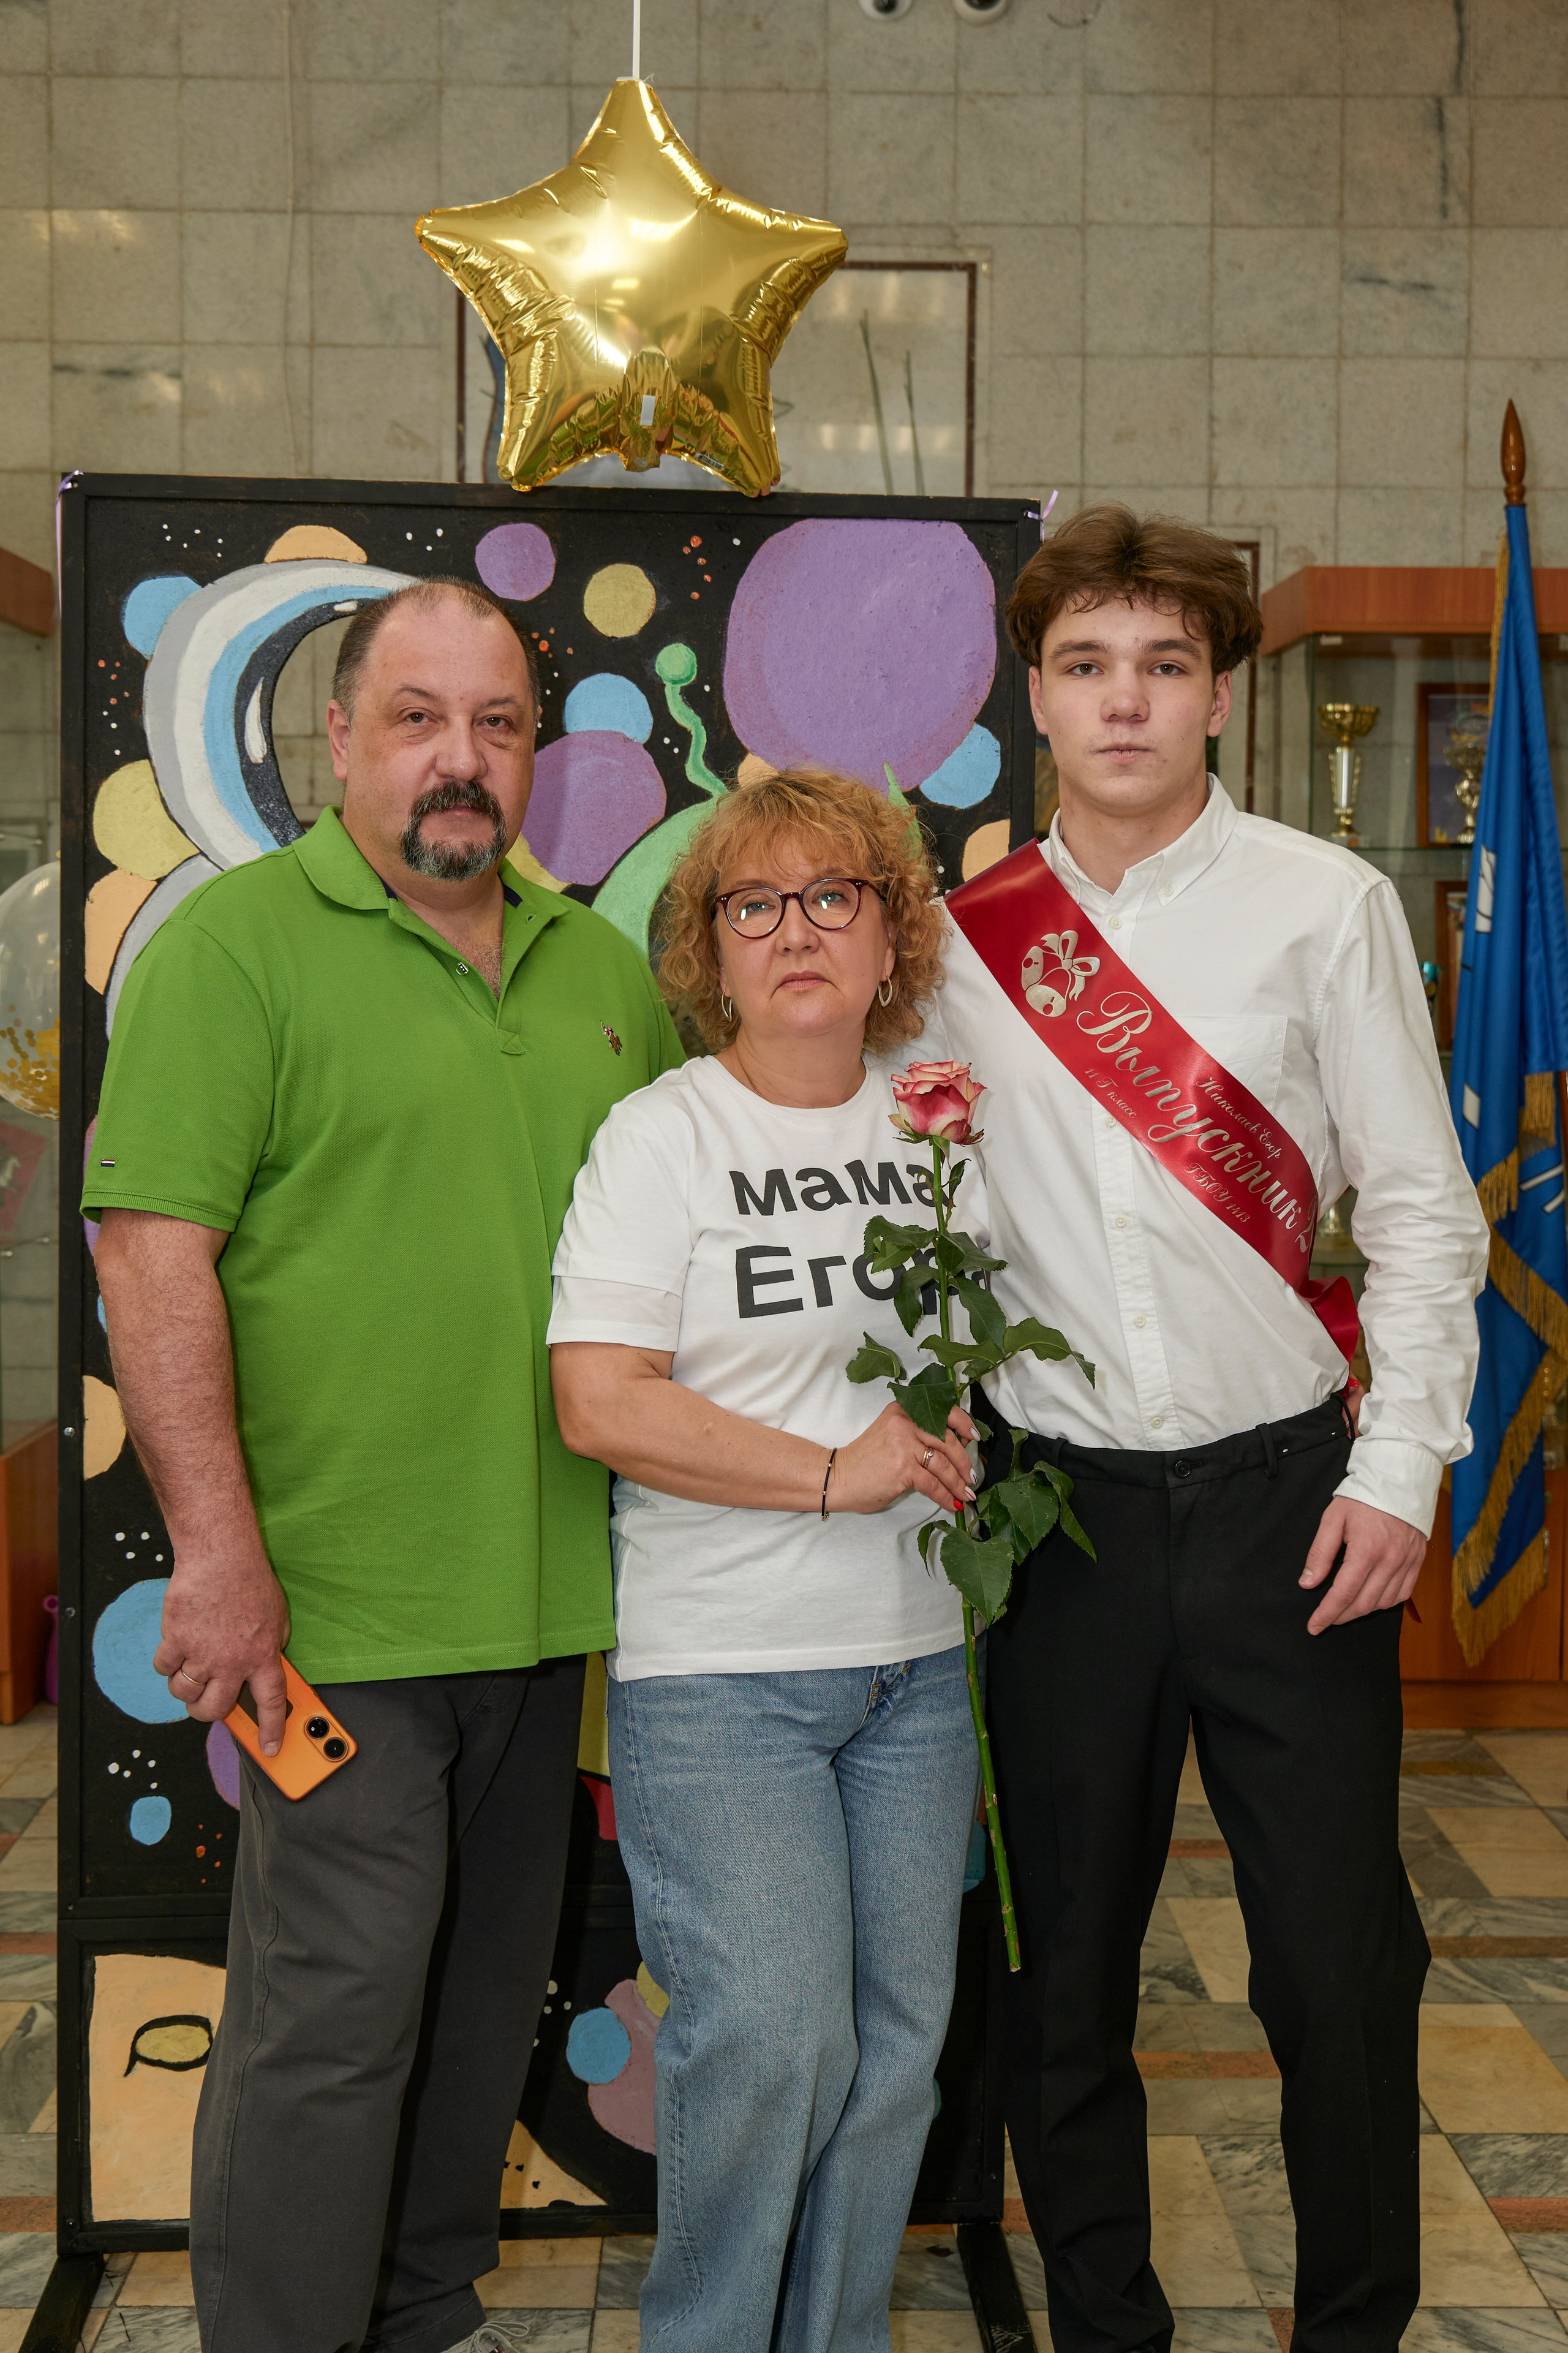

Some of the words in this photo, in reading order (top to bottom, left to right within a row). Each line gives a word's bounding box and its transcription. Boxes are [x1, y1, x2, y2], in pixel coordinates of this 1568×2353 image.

[1076, 991, 1302, 1229] Выпускник
[1084, 1068, 1099, 1078] 11
[1107, 1092, 1137, 1119] класс
[1196, 1076, 1262, 1133] Николаев
[1259, 1128, 1282, 1159] Егор
[1183, 1162, 1234, 1202] ГБОУ
[1226, 1203, 1251, 1223] 1413
